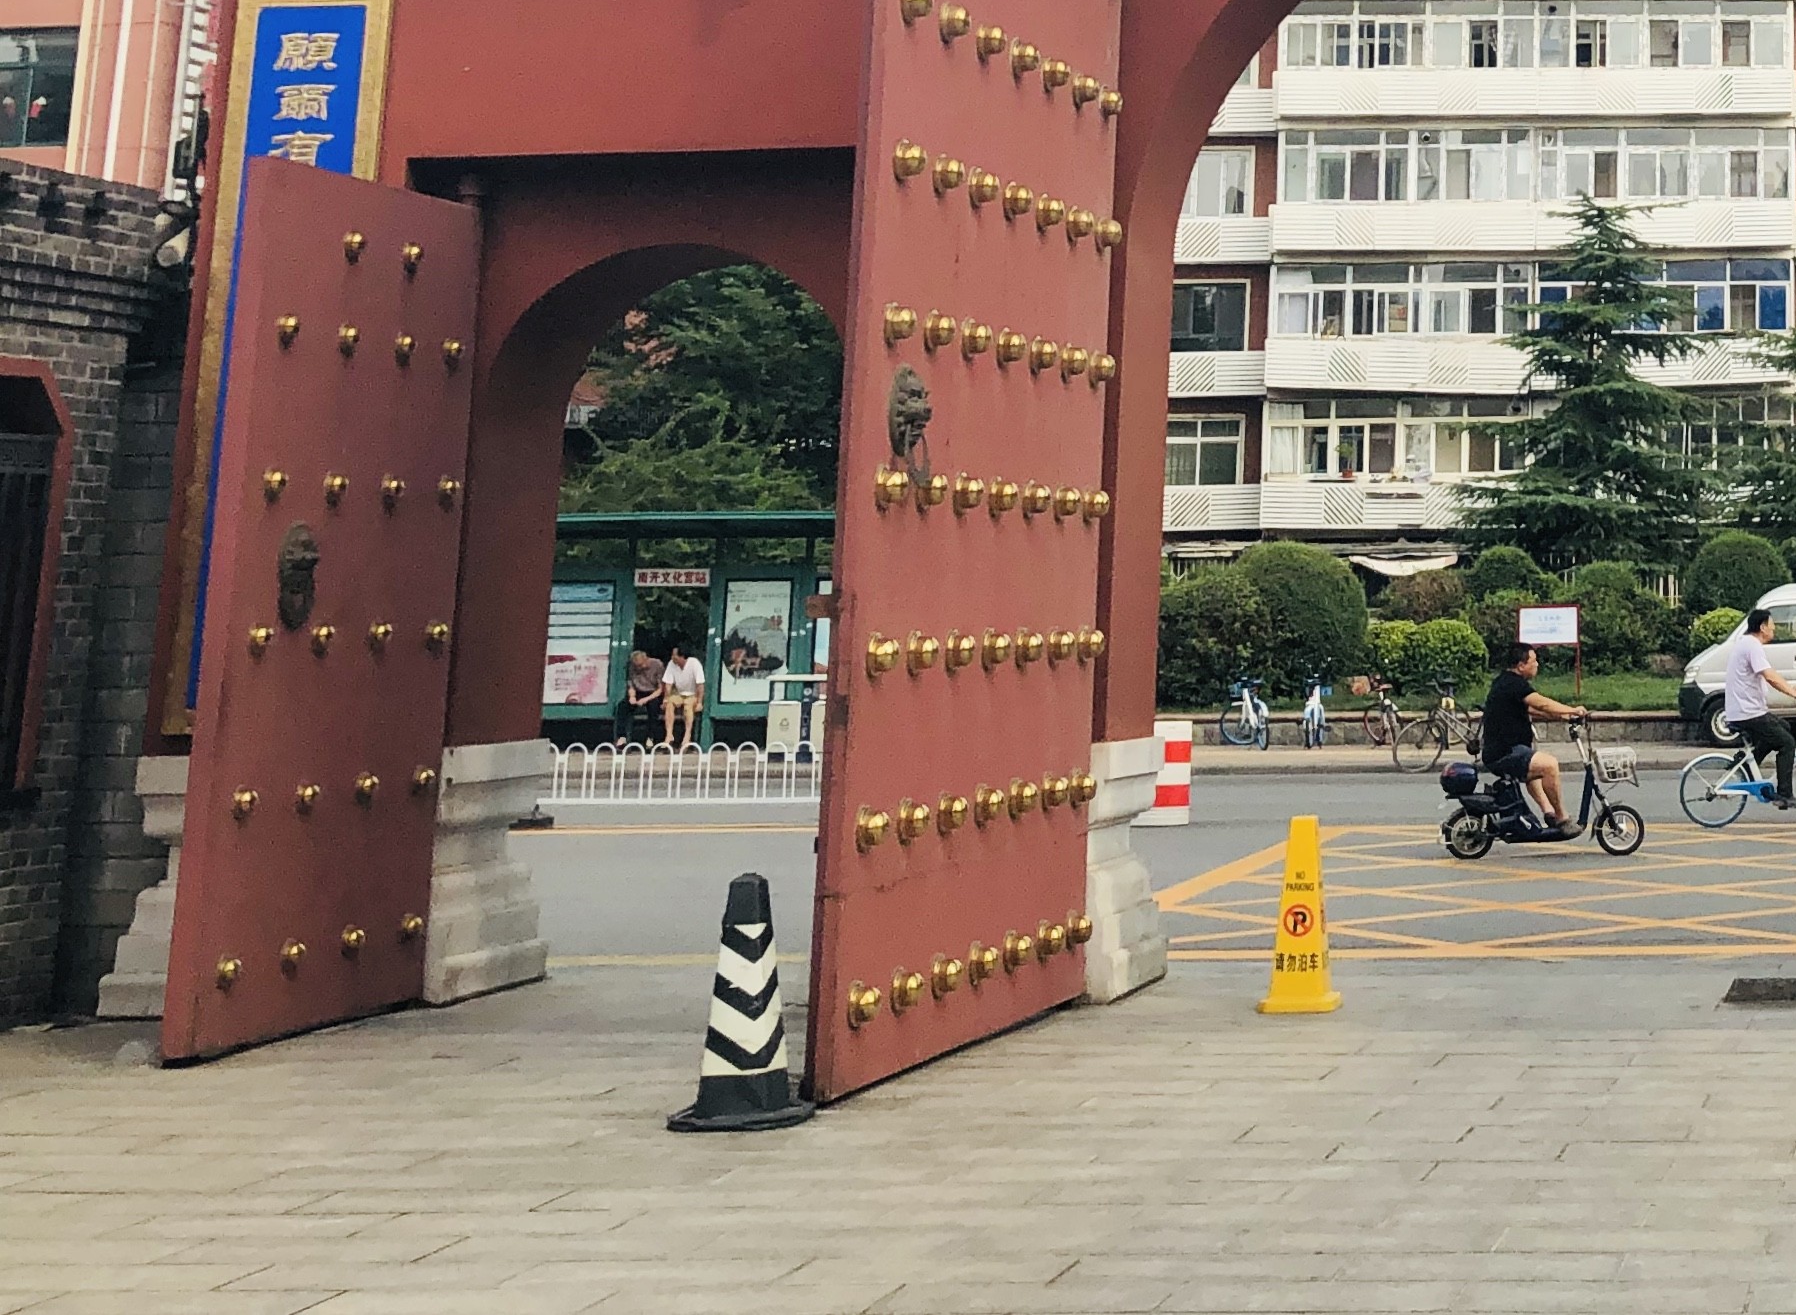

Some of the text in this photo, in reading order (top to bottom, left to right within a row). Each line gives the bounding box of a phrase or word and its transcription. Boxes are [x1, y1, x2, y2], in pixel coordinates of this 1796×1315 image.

[637, 571, 707, 584] 南开文化宫站
[1296, 872, 1305, 880] NO
[1286, 882, 1314, 891] PARKING
[1275, 952, 1319, 972] 请勿泊车
